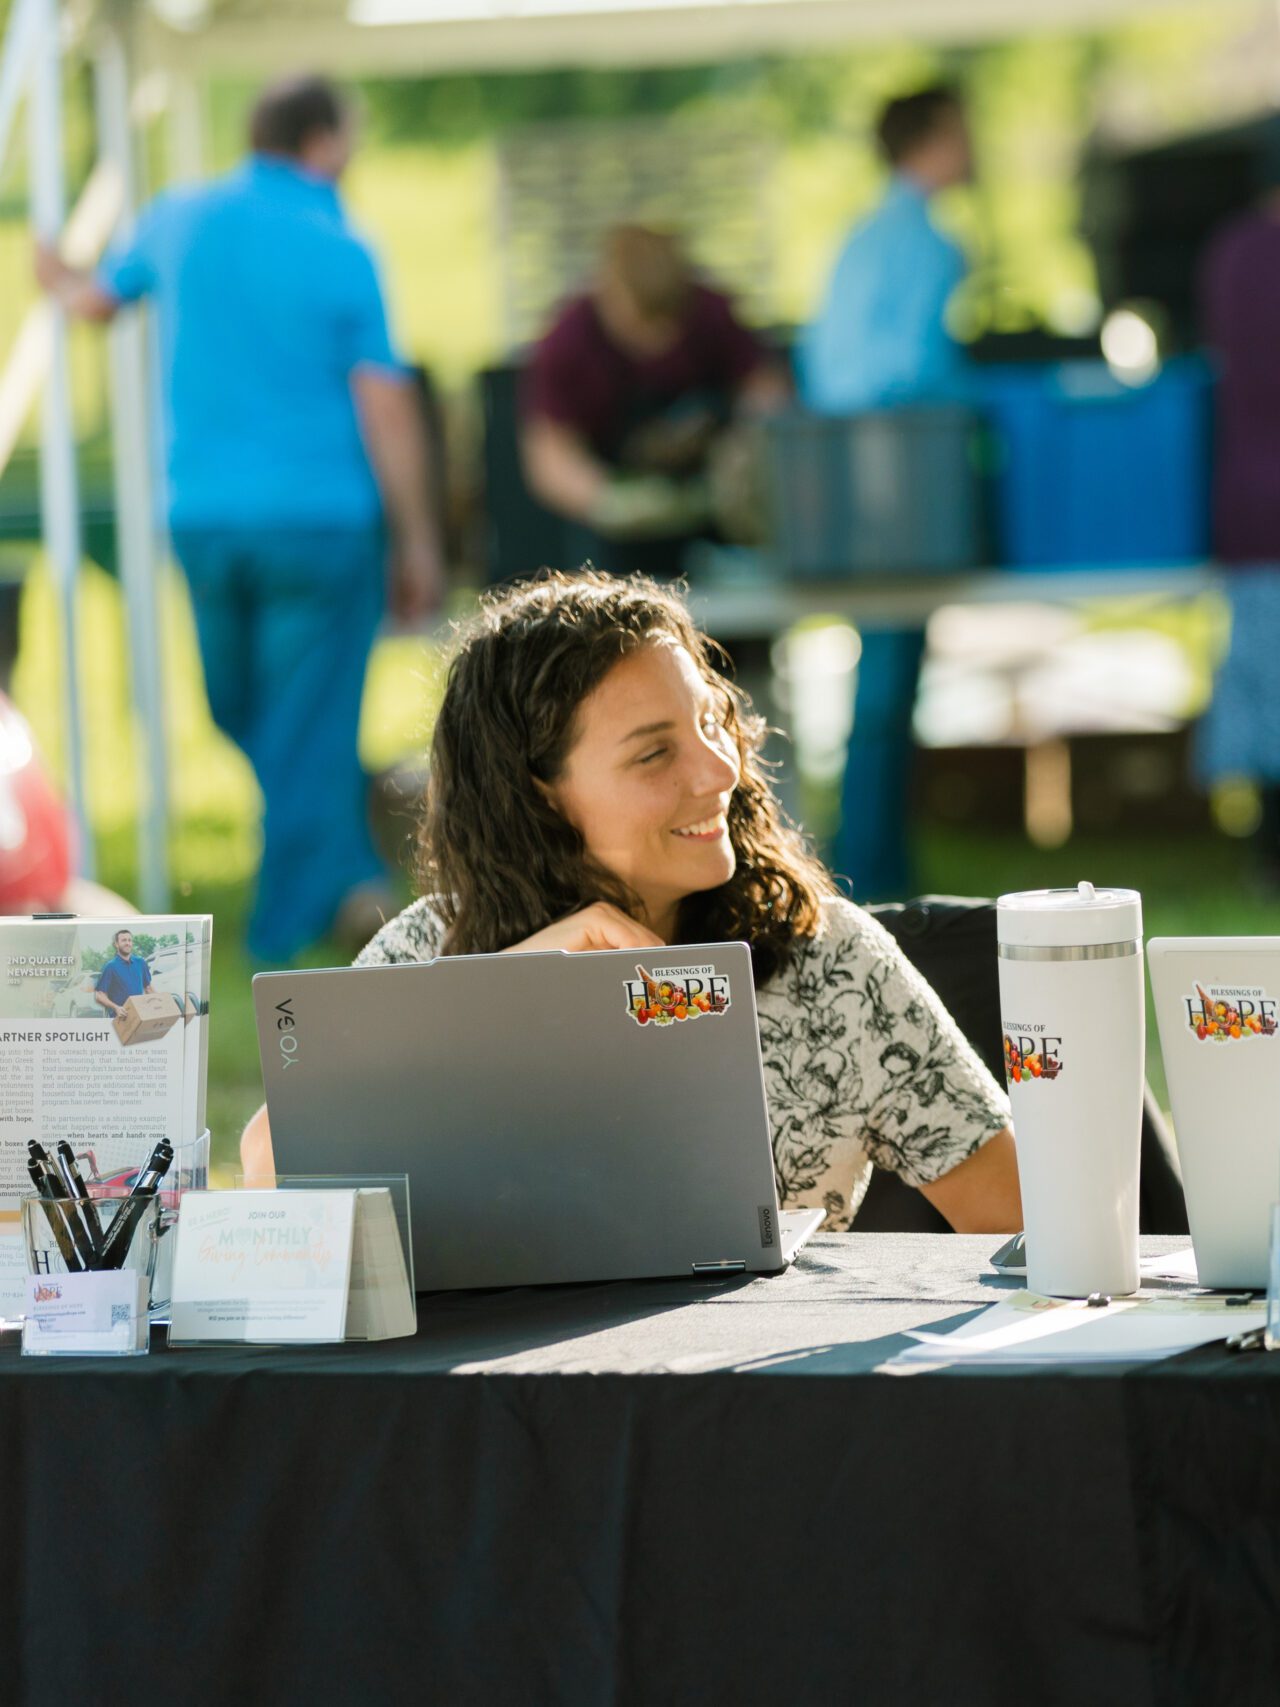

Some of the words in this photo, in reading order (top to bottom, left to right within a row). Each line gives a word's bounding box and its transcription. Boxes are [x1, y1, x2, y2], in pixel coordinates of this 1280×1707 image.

[28, 956, 74, 966] QUARTER
[8, 968, 68, 977] NEWSLETTER
[654, 968, 700, 977] BLESSINGS
[701, 966, 713, 975] OF
[625, 977, 729, 1011] HOPE
[1211, 988, 1251, 996] BLESSINGS
[1252, 989, 1264, 997] OF
[1185, 998, 1279, 1028] HOPE
[1033, 1024, 1046, 1033] OF
[45, 1032, 110, 1042] SPOTLIGHT
[275, 998, 299, 1070] YOGA
[248, 1211, 267, 1220] JOIN
[268, 1210, 287, 1219] OUR
[763, 1208, 773, 1245] Lenovo
